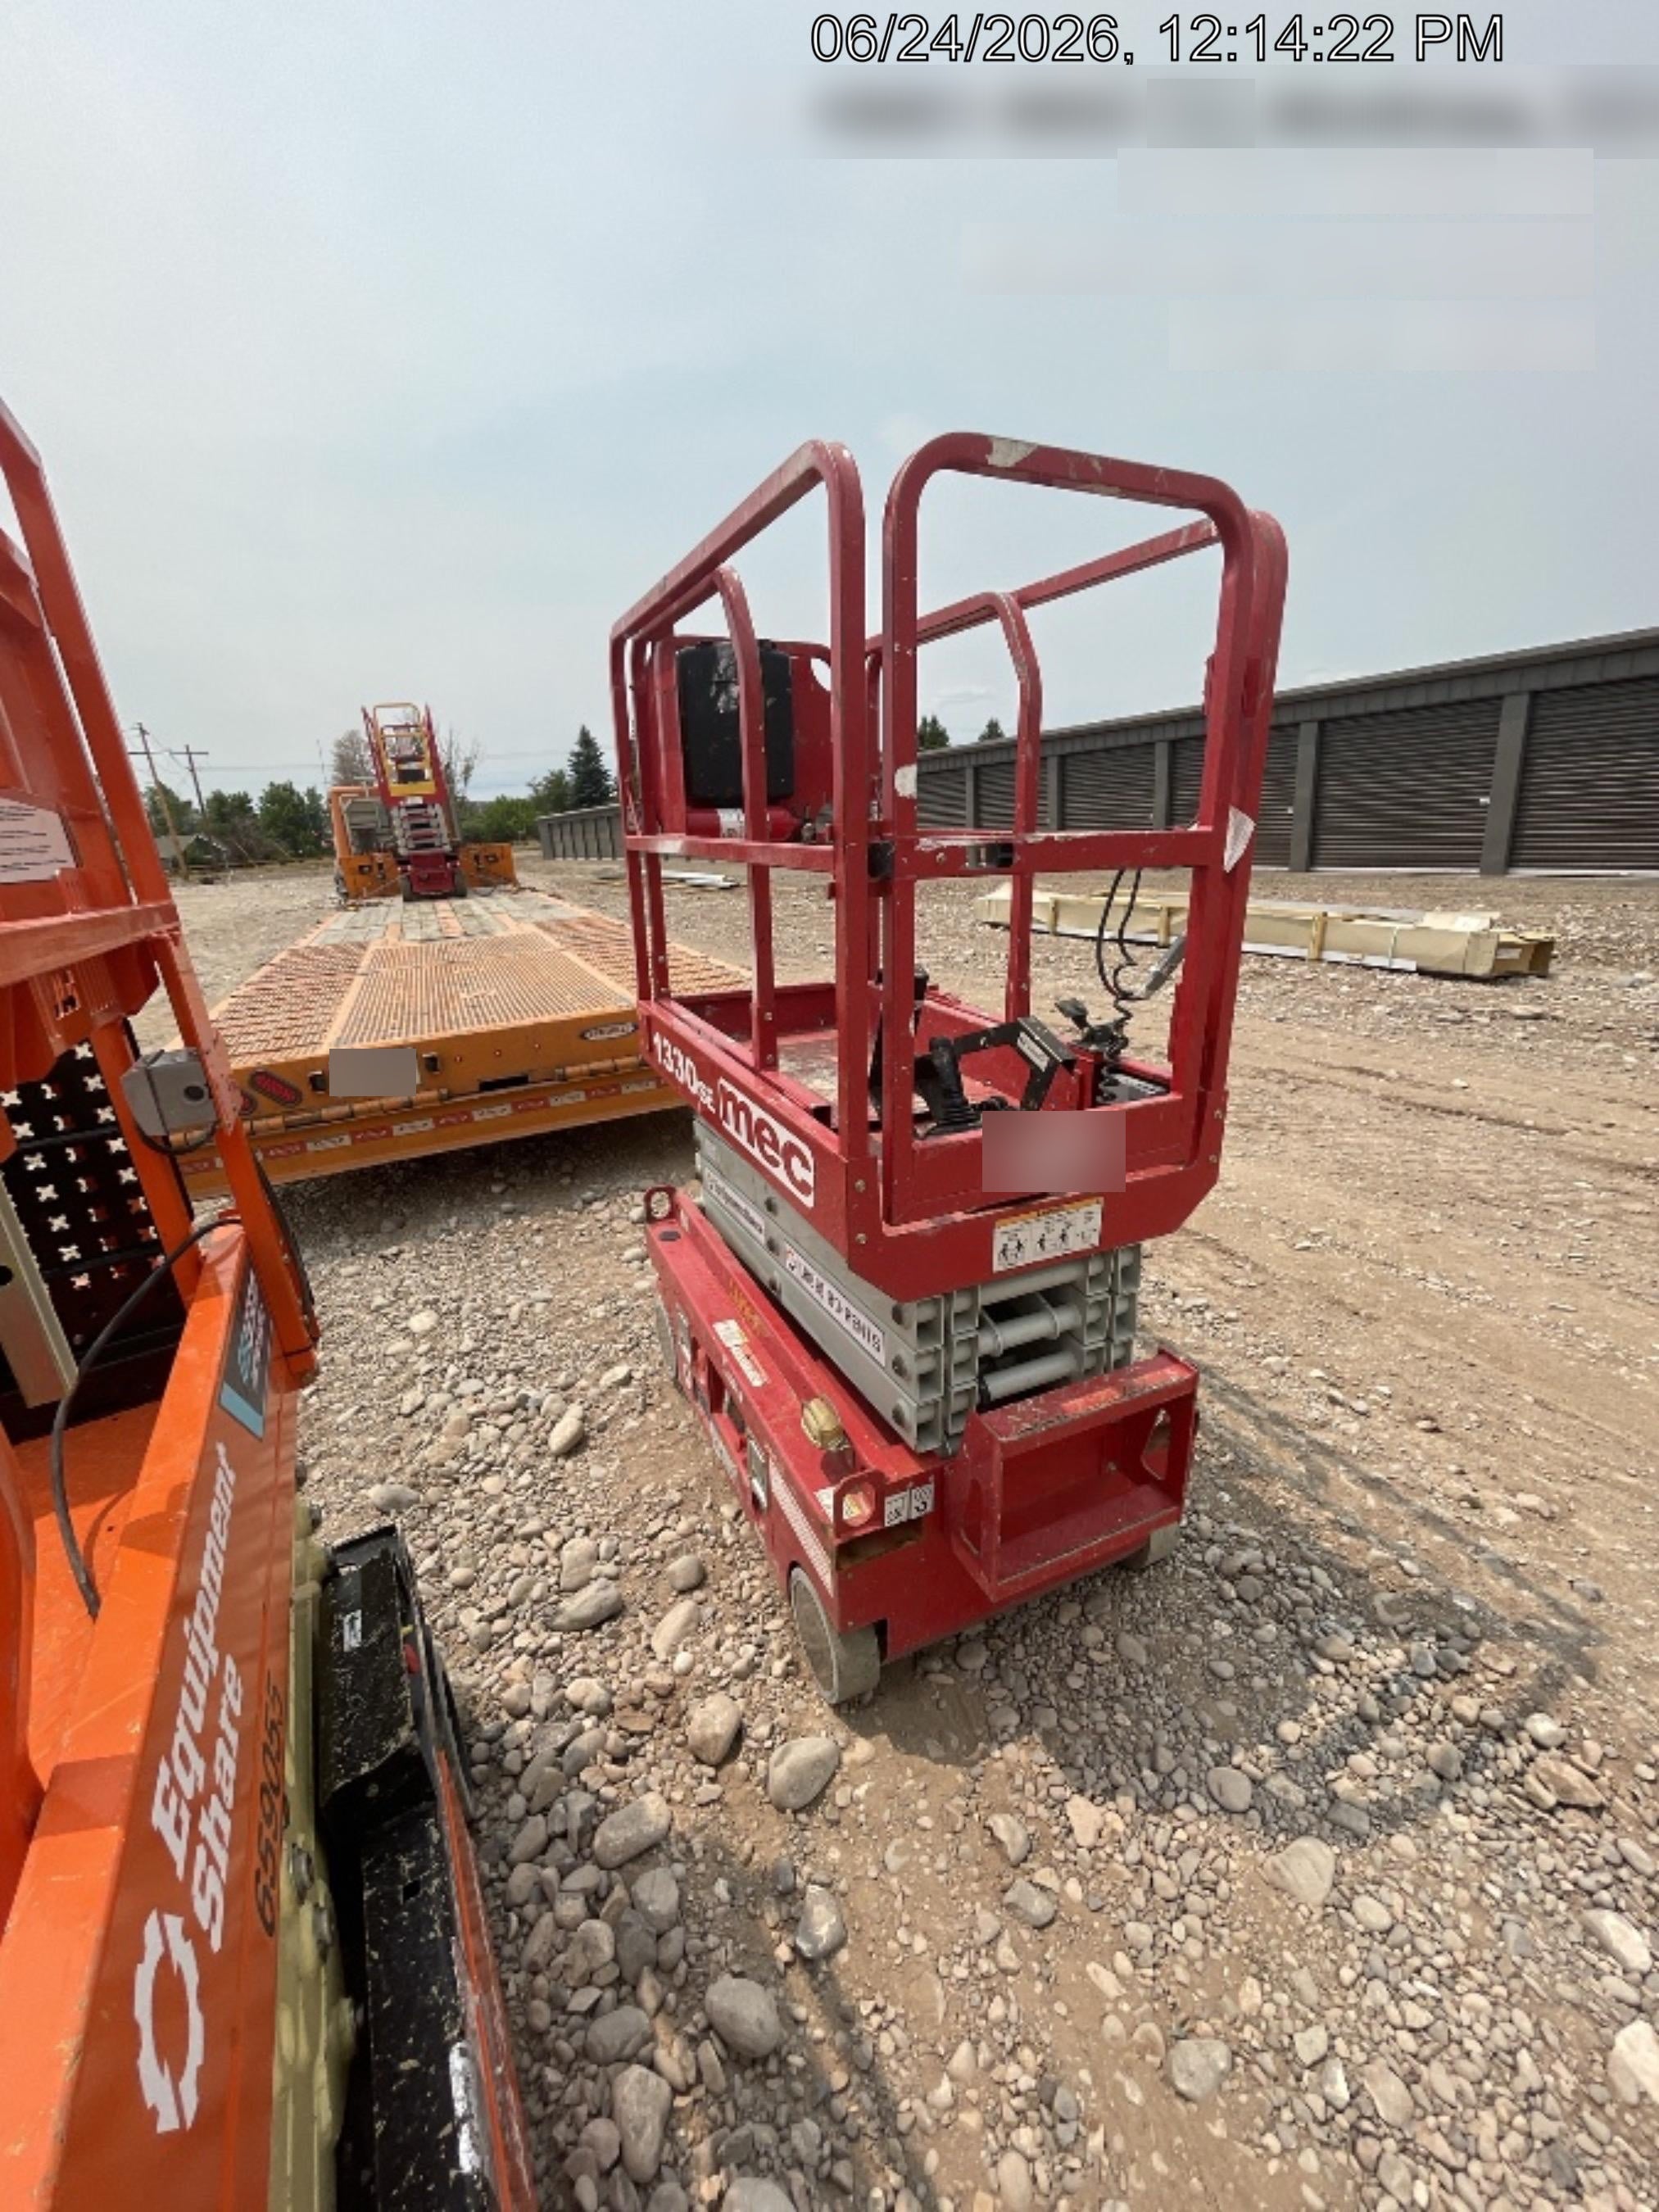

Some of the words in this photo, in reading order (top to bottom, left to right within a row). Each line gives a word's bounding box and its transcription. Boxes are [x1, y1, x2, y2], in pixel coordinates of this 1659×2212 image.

[718, 1085, 813, 1199] mec
[152, 1442, 236, 1882] Equipment
[192, 1653, 243, 1953] Share
